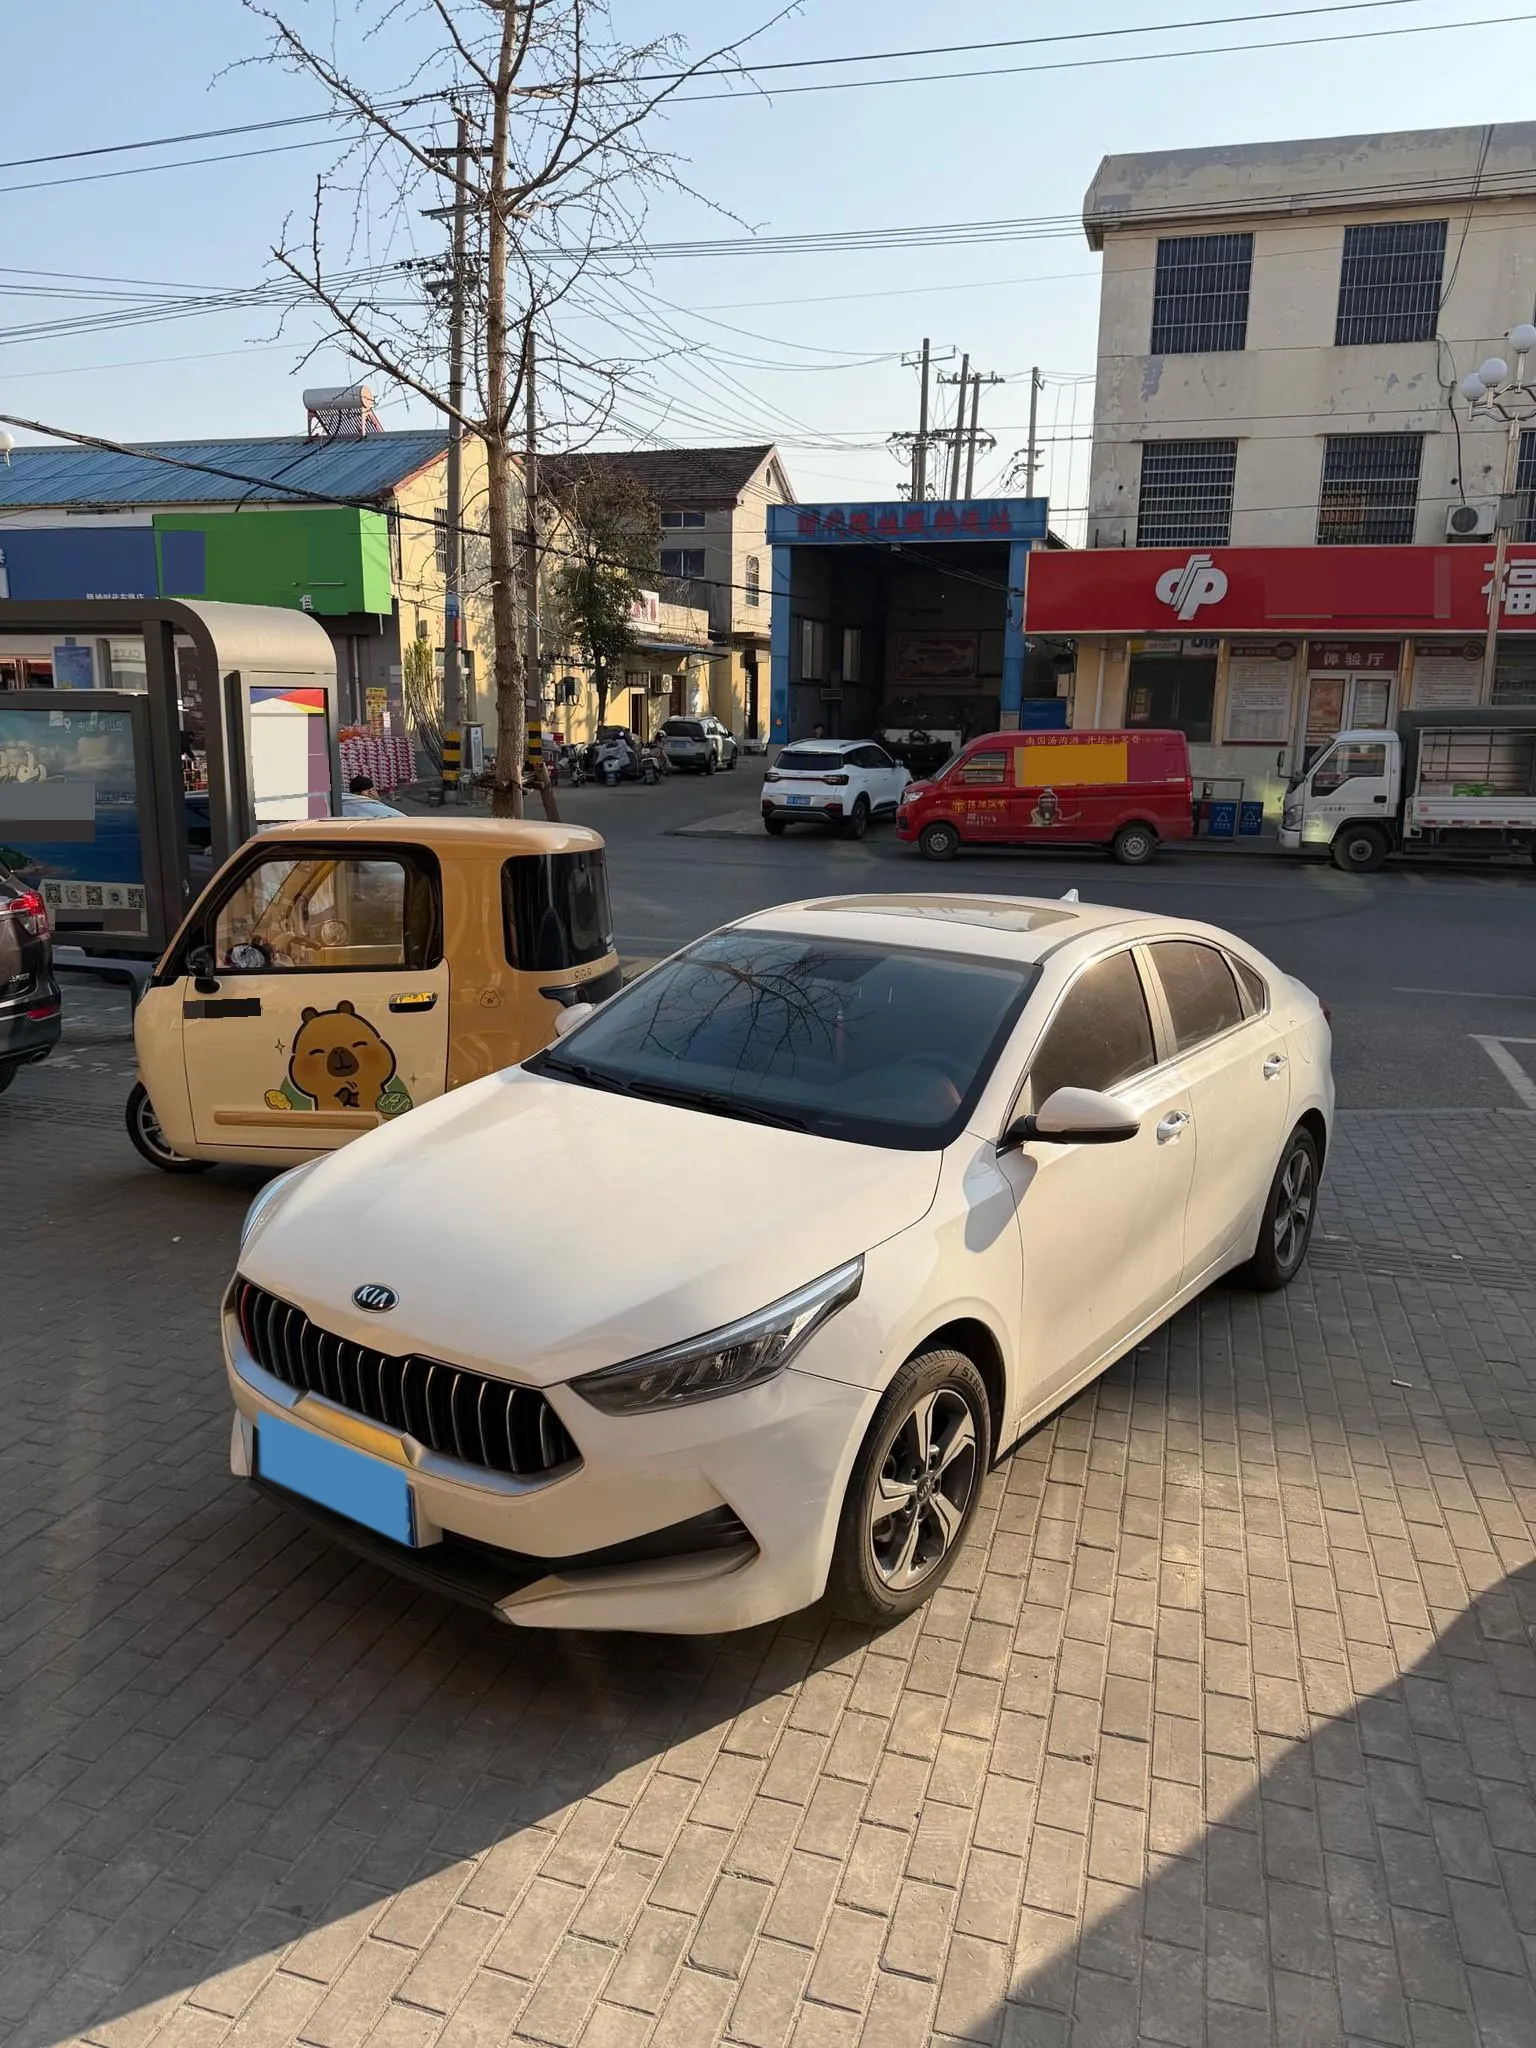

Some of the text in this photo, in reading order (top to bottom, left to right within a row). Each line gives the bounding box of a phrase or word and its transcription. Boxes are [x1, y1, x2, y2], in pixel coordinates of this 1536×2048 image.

[1323, 652, 1385, 666] 体验厅
[356, 1285, 390, 1308] KIA
